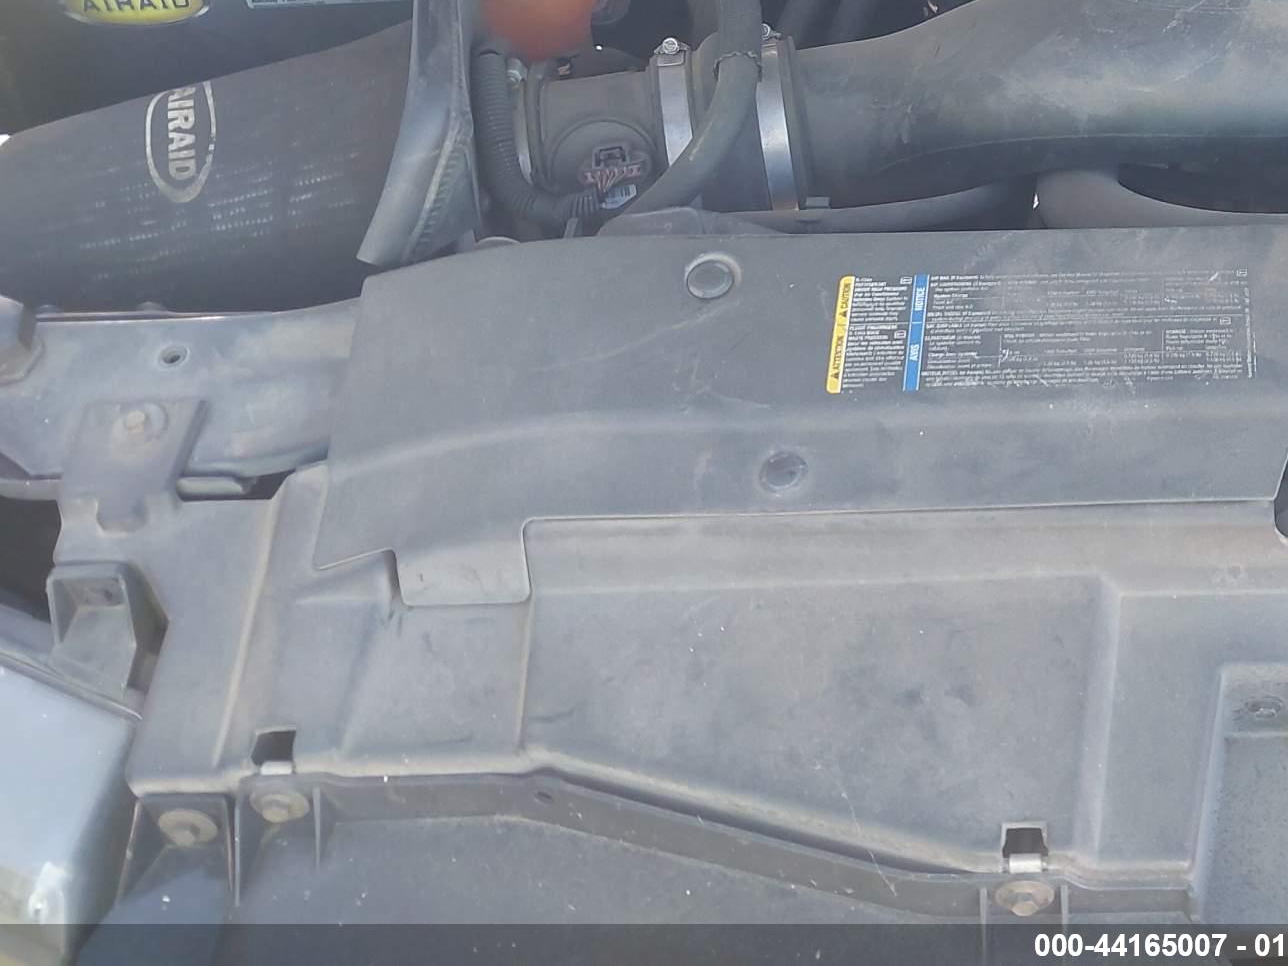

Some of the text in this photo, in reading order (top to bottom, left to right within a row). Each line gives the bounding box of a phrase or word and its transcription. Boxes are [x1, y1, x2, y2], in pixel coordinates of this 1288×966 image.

[167, 86, 197, 181] AIRAID
[840, 282, 851, 309] CAUTION
[914, 286, 925, 311] NOTICE
[831, 335, 844, 371] ATTENTION
[909, 343, 920, 362] AVIS
